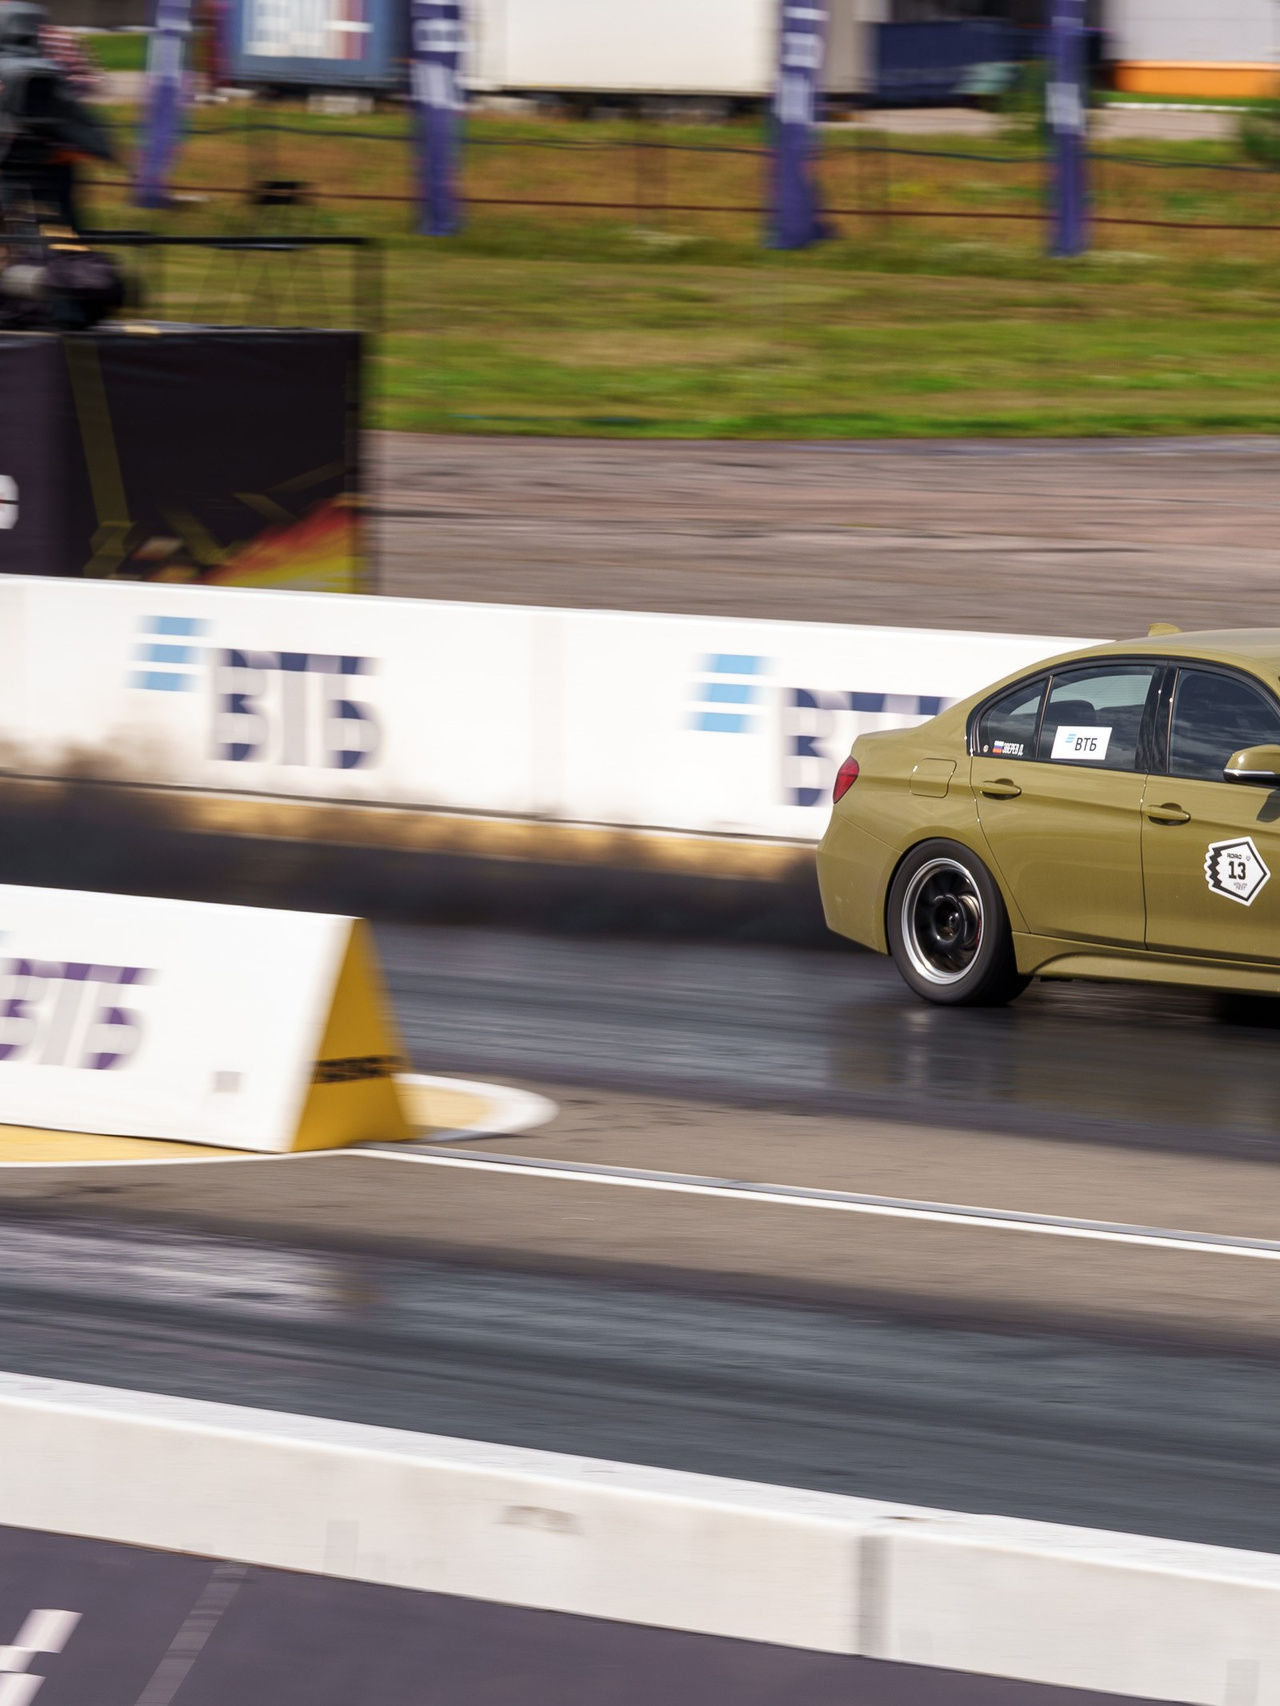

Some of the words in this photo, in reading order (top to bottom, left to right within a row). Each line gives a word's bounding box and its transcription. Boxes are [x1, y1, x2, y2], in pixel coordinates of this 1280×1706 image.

[208, 648, 386, 770] ВТБ
[1074, 737, 1098, 752] ВТБ
[1228, 860, 1247, 881] 13
